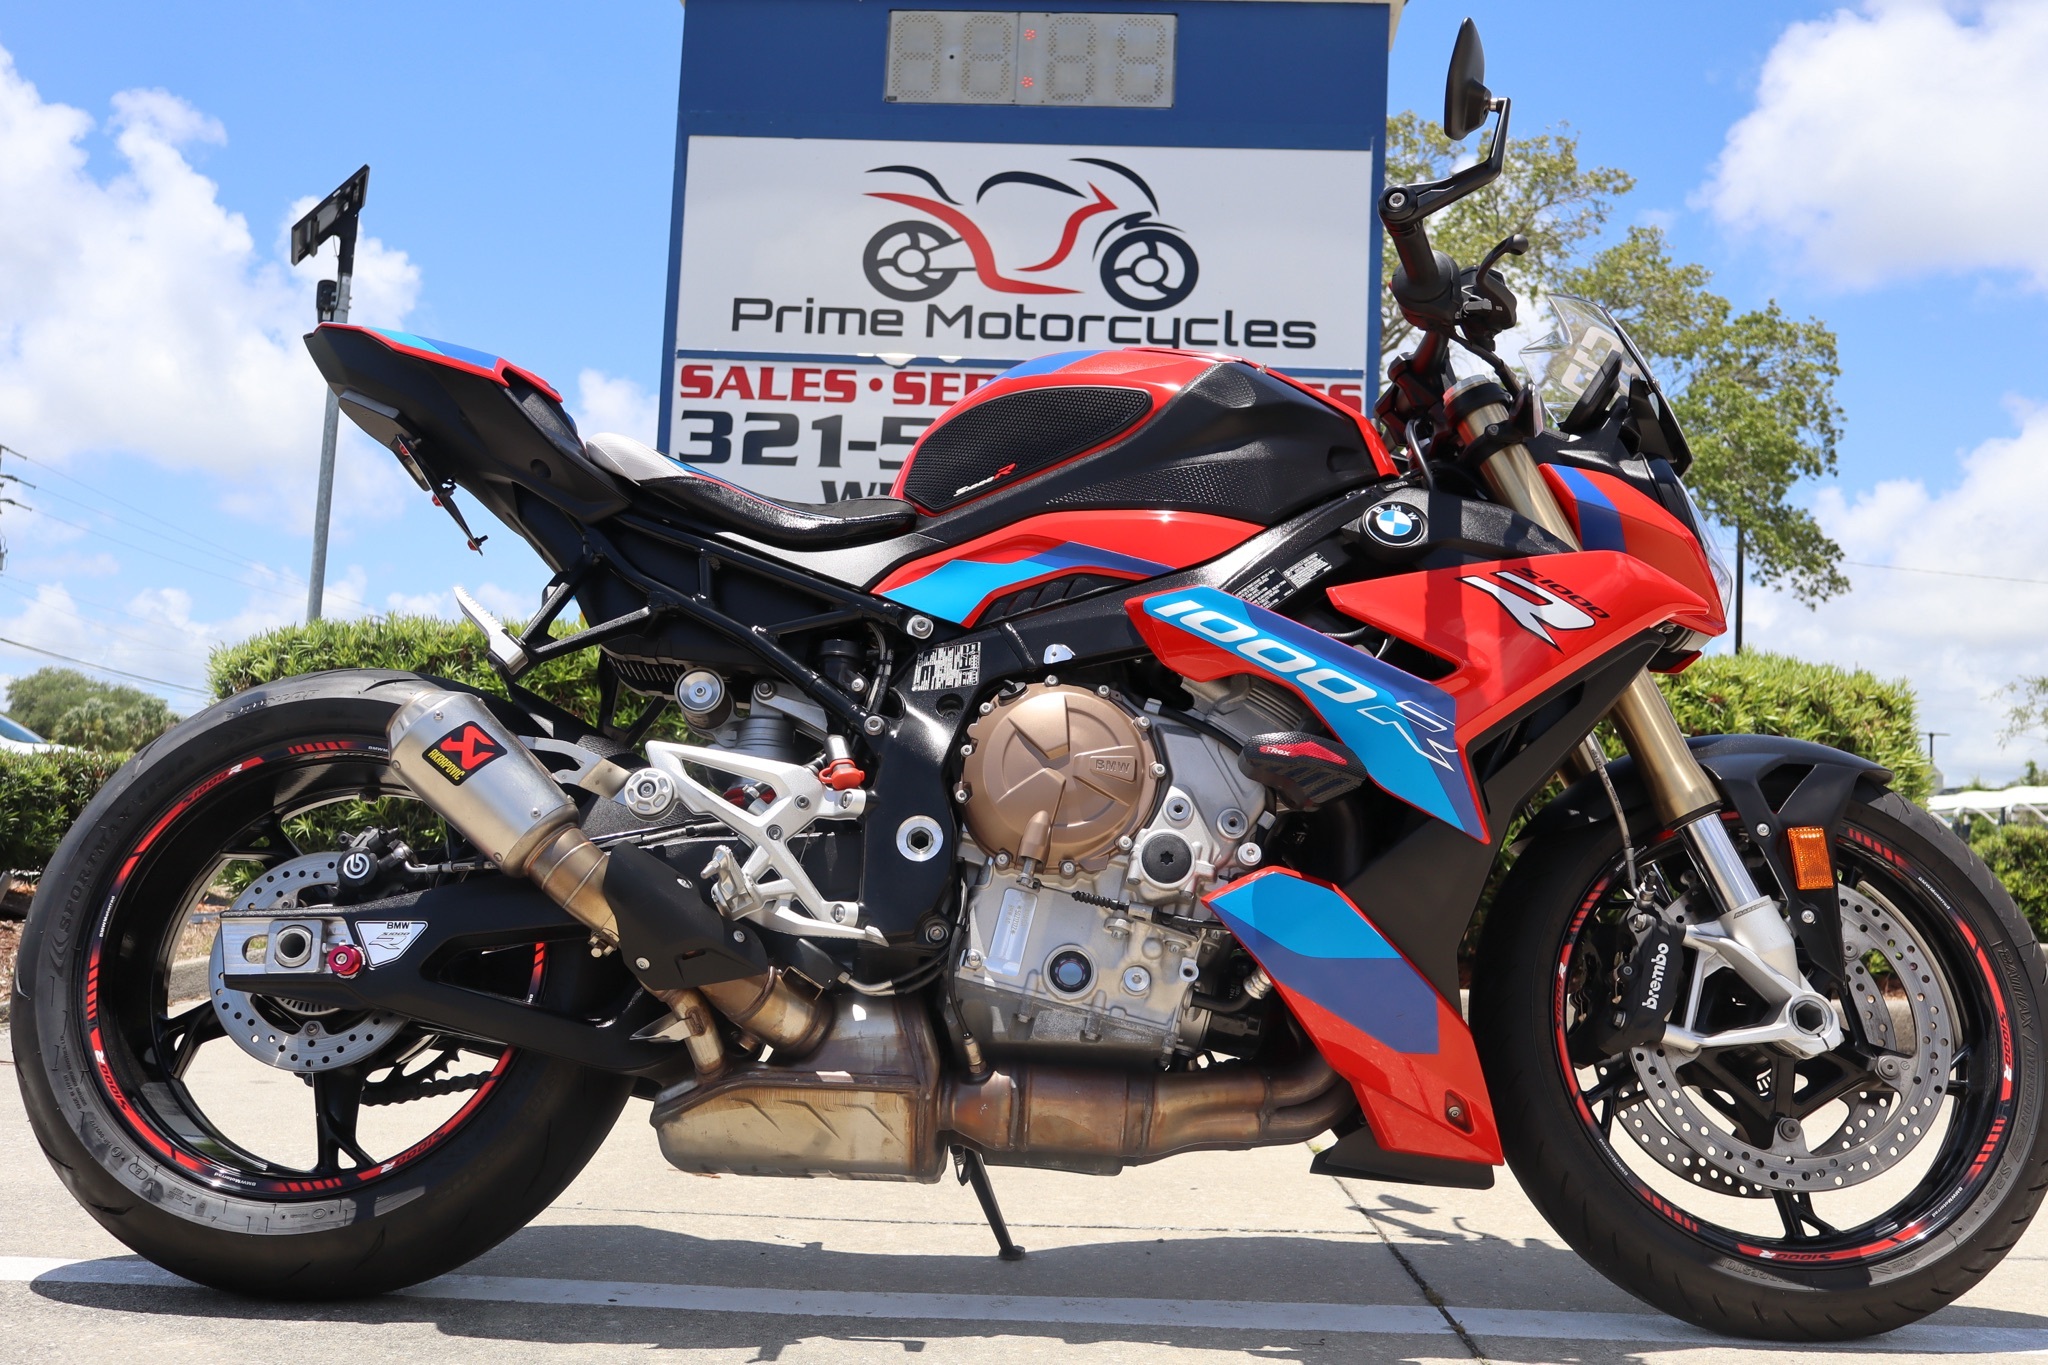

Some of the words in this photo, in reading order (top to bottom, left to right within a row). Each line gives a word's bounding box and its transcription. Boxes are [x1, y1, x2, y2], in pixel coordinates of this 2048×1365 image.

[732, 297, 904, 337] Prime
[926, 303, 1317, 350] Motorcycles
[680, 365, 857, 403] SALES
[1373, 503, 1420, 521] BMW
[1512, 567, 1611, 619] S1000
[1095, 759, 1131, 773] BMW
[386, 922, 410, 930] BMW
[1641, 942, 1670, 1010] brembo
[2000, 1010, 2013, 1082] S1000R
[94, 1049, 127, 1111] S1000R
